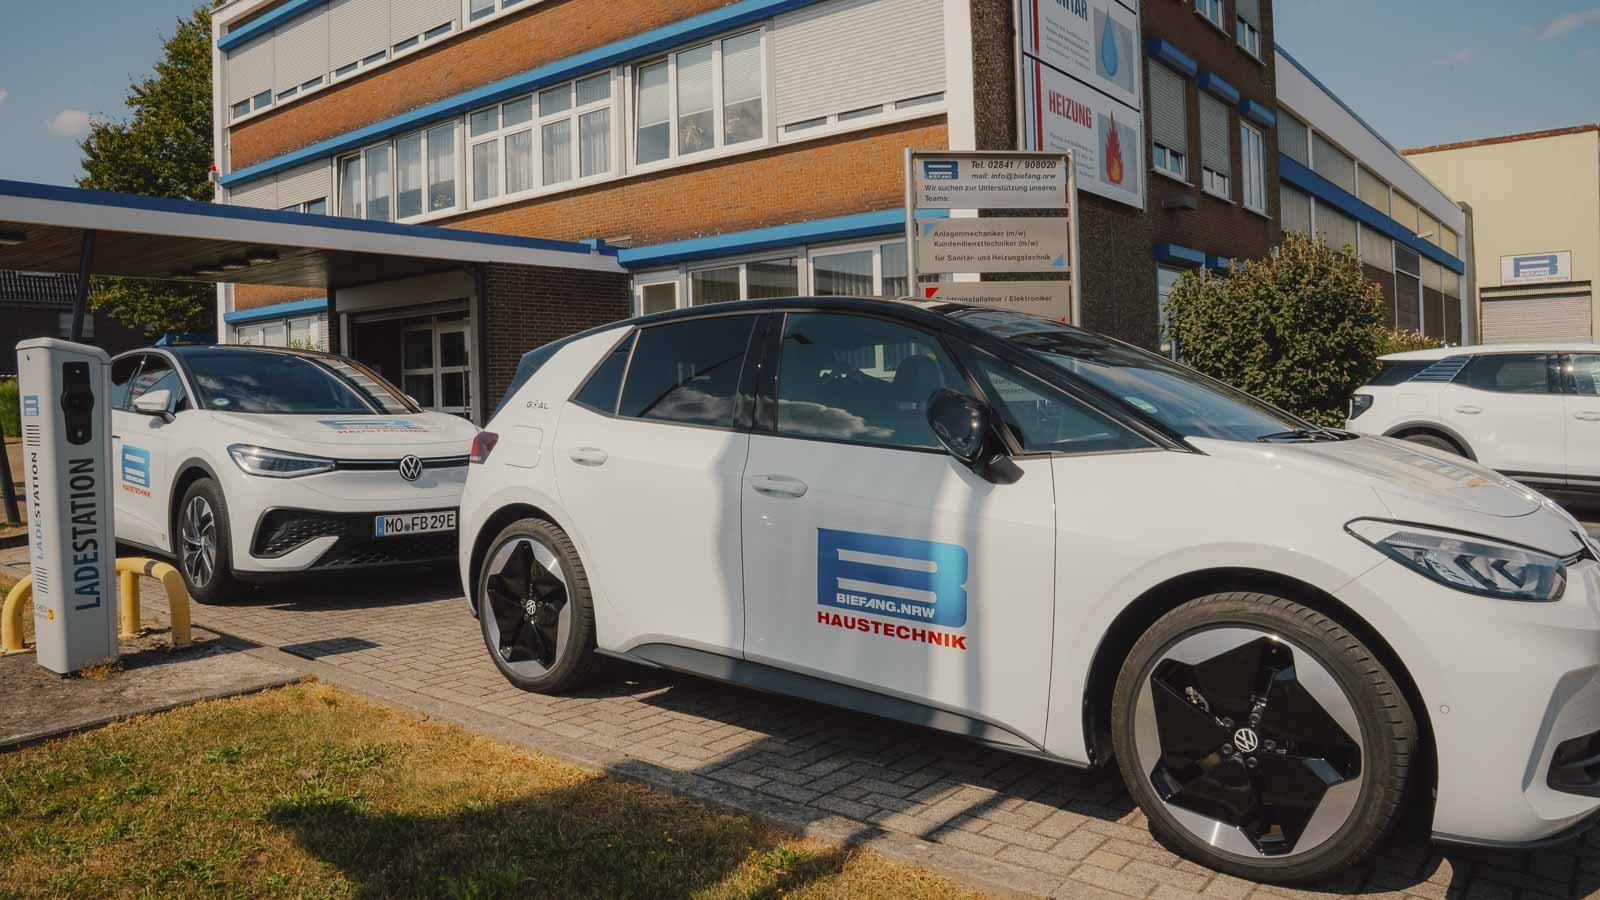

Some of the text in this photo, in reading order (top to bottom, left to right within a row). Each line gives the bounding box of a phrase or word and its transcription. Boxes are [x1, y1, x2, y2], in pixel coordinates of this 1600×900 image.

[1048, 89, 1092, 129] HEIZUNG
[971, 160, 1057, 169] Tel. 02841 / 908020
[991, 173, 1057, 181] info@biefang.nrw
[924, 184, 936, 192] Wir
[938, 184, 963, 192] suchen
[978, 184, 1028, 193] Unterstützung
[934, 231, 1026, 240] Anlagenmechaniker (m/w)
[1019, 240, 1039, 248] (m/w)
[992, 254, 1051, 262] Heizungstechnik
[31, 452, 44, 560] LADESTATION
[68, 457, 101, 611] LADESTATION
[836, 592, 936, 619] BIEFANG.NRW
[817, 611, 967, 650] HAUSTECHNIK
